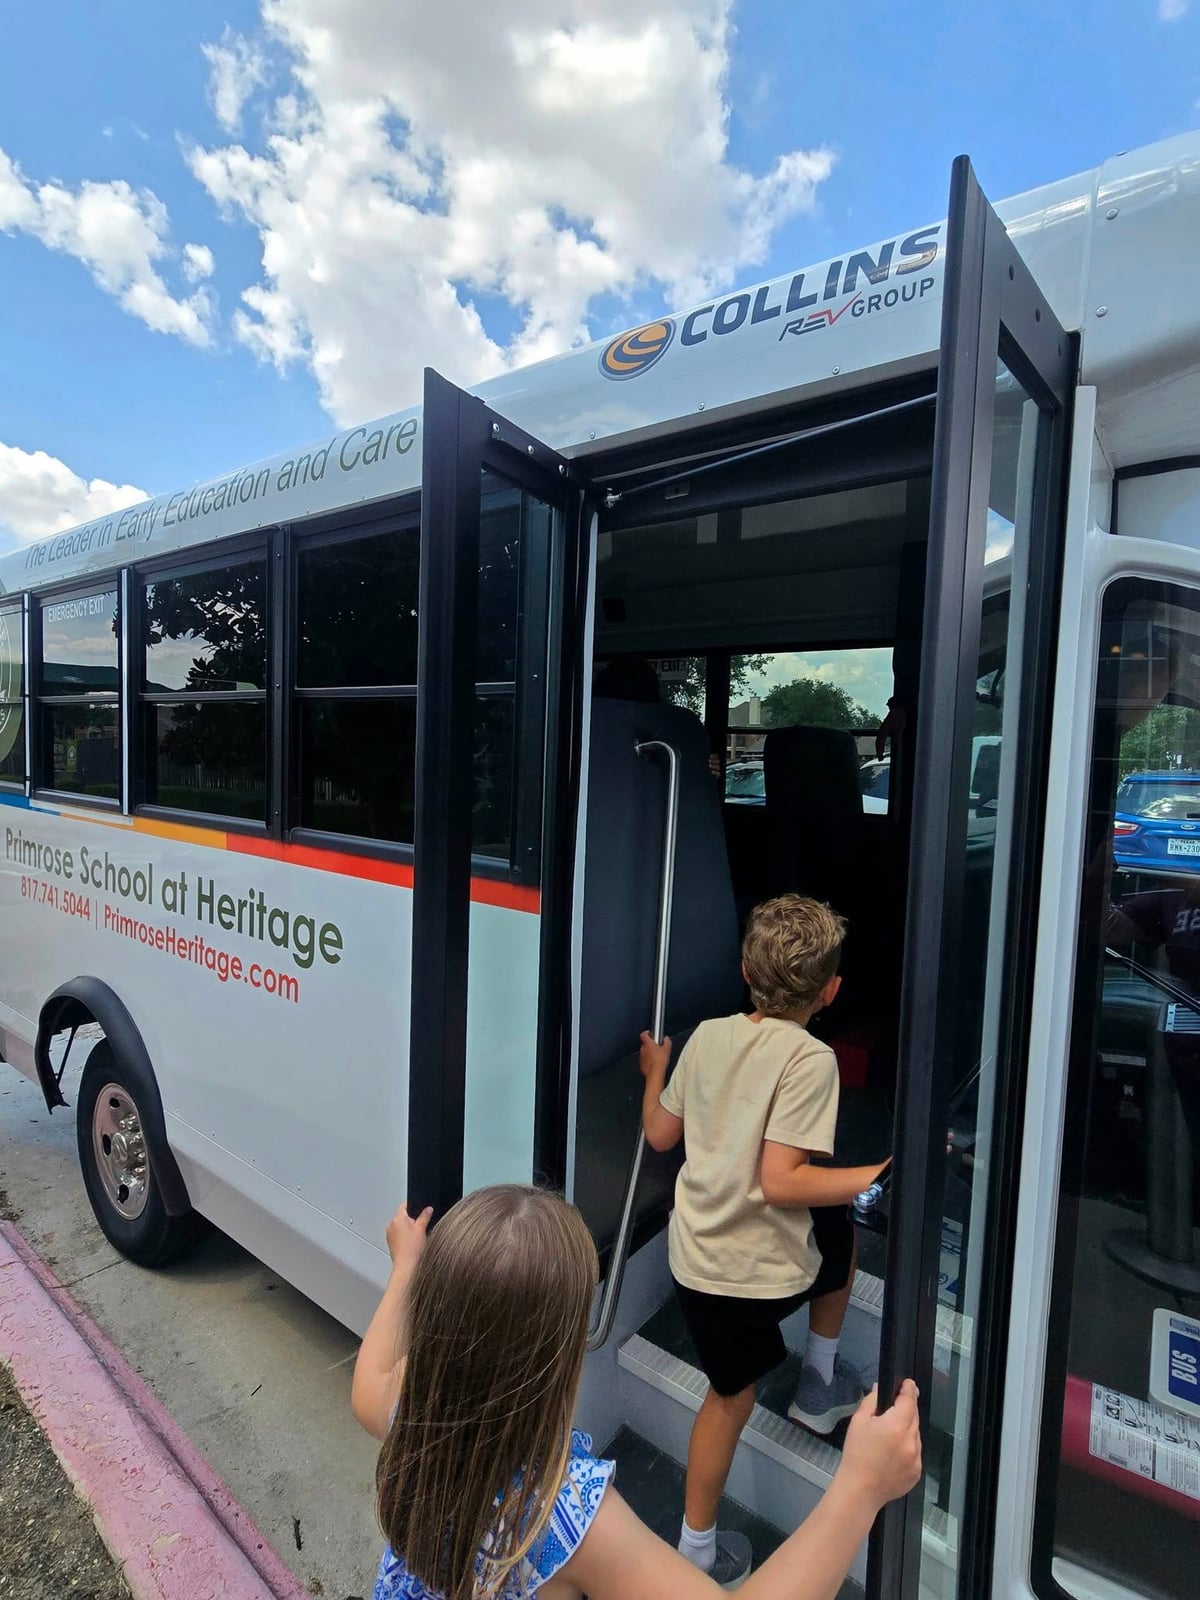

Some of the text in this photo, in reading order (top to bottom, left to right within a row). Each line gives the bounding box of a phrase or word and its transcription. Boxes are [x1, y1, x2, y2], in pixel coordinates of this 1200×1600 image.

[680, 225, 942, 347] COLLINS
[778, 277, 935, 341] REV GROUP
[24, 417, 418, 569] The Leader in Early Education and Care
[48, 597, 105, 623] EMERGENCY EXIT
[6, 827, 344, 969] Primrose School at Heritage
[21, 875, 299, 1003] 817.741.5044 PrimroseHeritage.com
[1171, 1349, 1198, 1386] BUS
